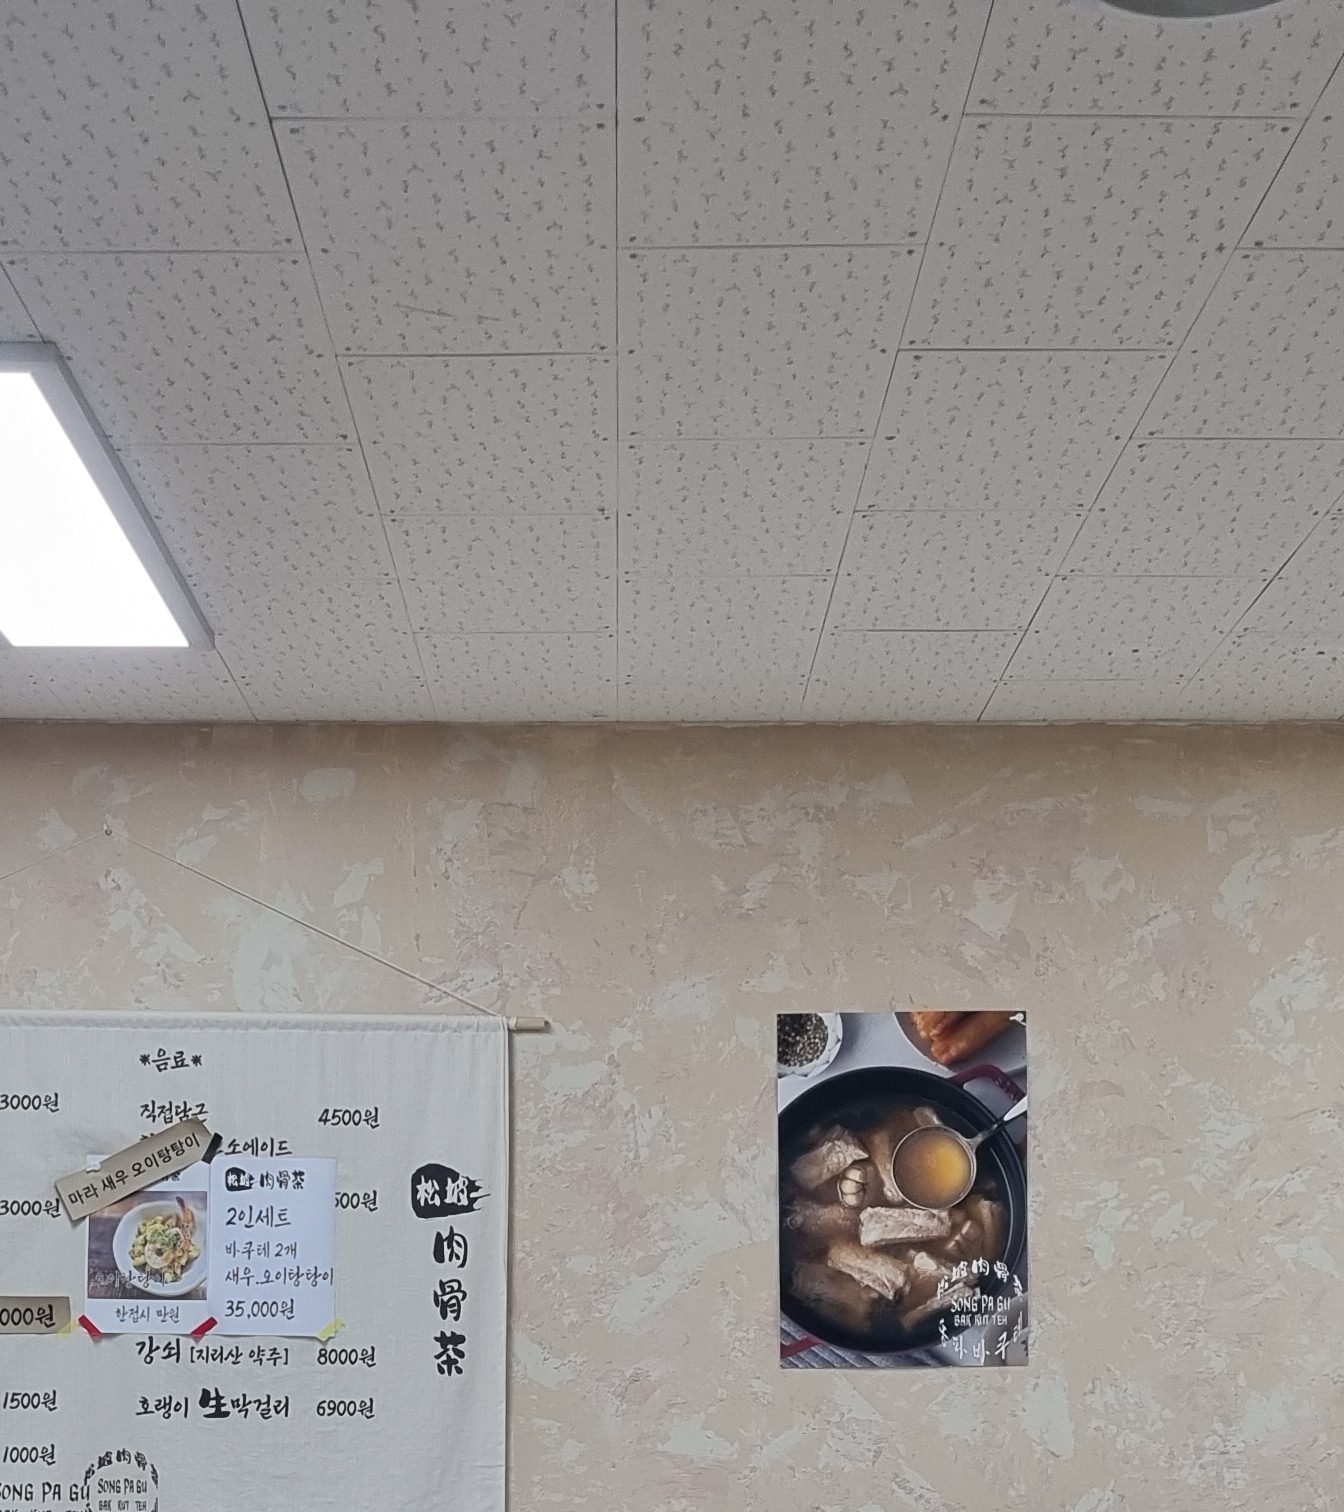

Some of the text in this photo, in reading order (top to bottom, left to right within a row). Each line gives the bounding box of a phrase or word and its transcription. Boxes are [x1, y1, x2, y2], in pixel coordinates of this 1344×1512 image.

[318, 1108, 381, 1129] 4500원
[217, 1137, 293, 1157] 소에이드
[68, 1184, 99, 1205] 마라
[101, 1169, 129, 1192] 새우
[132, 1132, 201, 1178] 오이탕탕이
[225, 1205, 292, 1229] 2인세트
[225, 1241, 298, 1260] 바쿠테 2개
[225, 1298, 295, 1321] 35,000원
[951, 1295, 1010, 1313] SONG PA GU
[115, 1306, 180, 1324] 한접시 만원
[954, 1314, 1007, 1326] BAK KUT TEH
[135, 1336, 181, 1365] 강쇠
[316, 1346, 377, 1368] 8000원
[2, 1390, 58, 1412] 1500원
[135, 1395, 189, 1419] 호랭이
[316, 1397, 376, 1419] 6900원
[2, 1444, 57, 1466] 1000원
[42, 1482, 61, 1503] PA
[69, 1484, 90, 1501] GU
[97, 1478, 147, 1495] SONG PA GU
[98, 1500, 146, 1511] BAK KUT TEH
